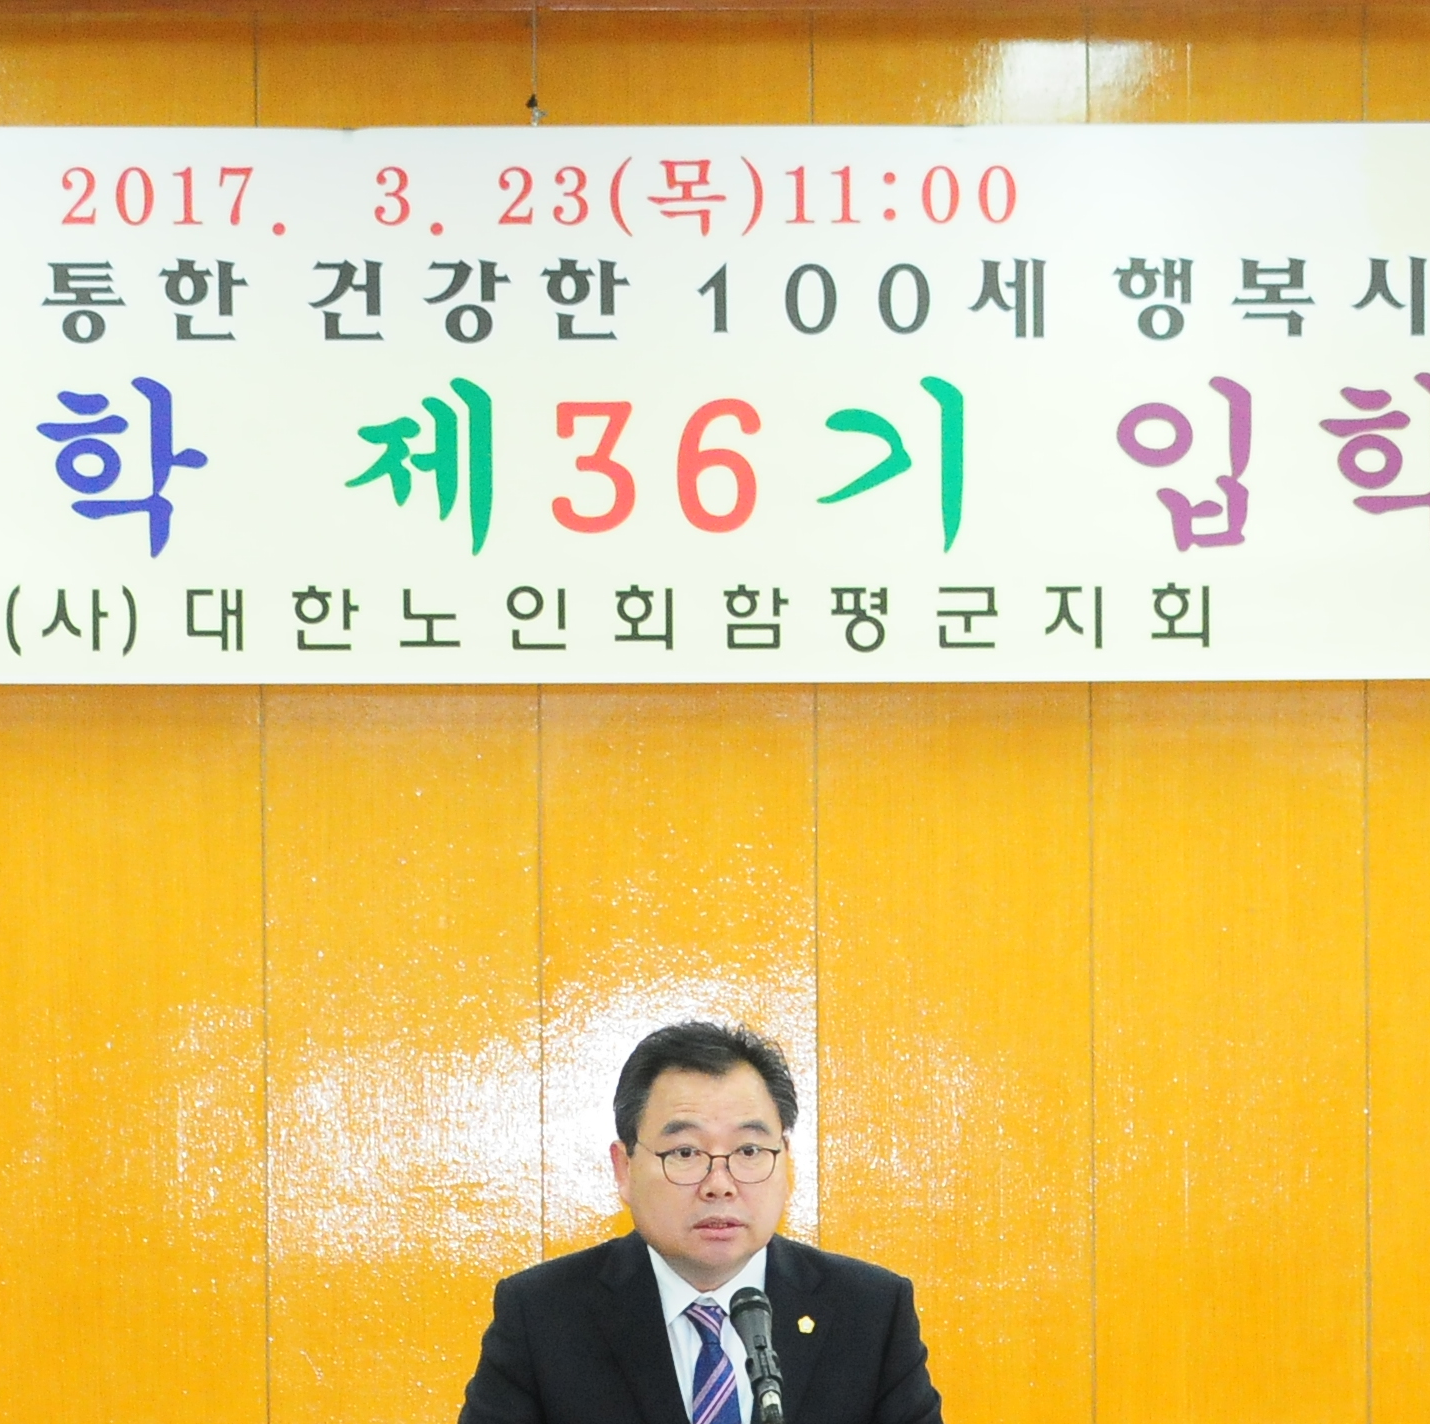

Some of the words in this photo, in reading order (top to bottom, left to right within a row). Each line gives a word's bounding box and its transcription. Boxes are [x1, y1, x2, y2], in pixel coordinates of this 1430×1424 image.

[60, 165, 286, 236] 2017.
[374, 165, 445, 235] 3.
[40, 257, 249, 344] 통한
[307, 257, 632, 344] 건강한
[696, 257, 1048, 341] 100세
[345, 375, 965, 556] 제36기
